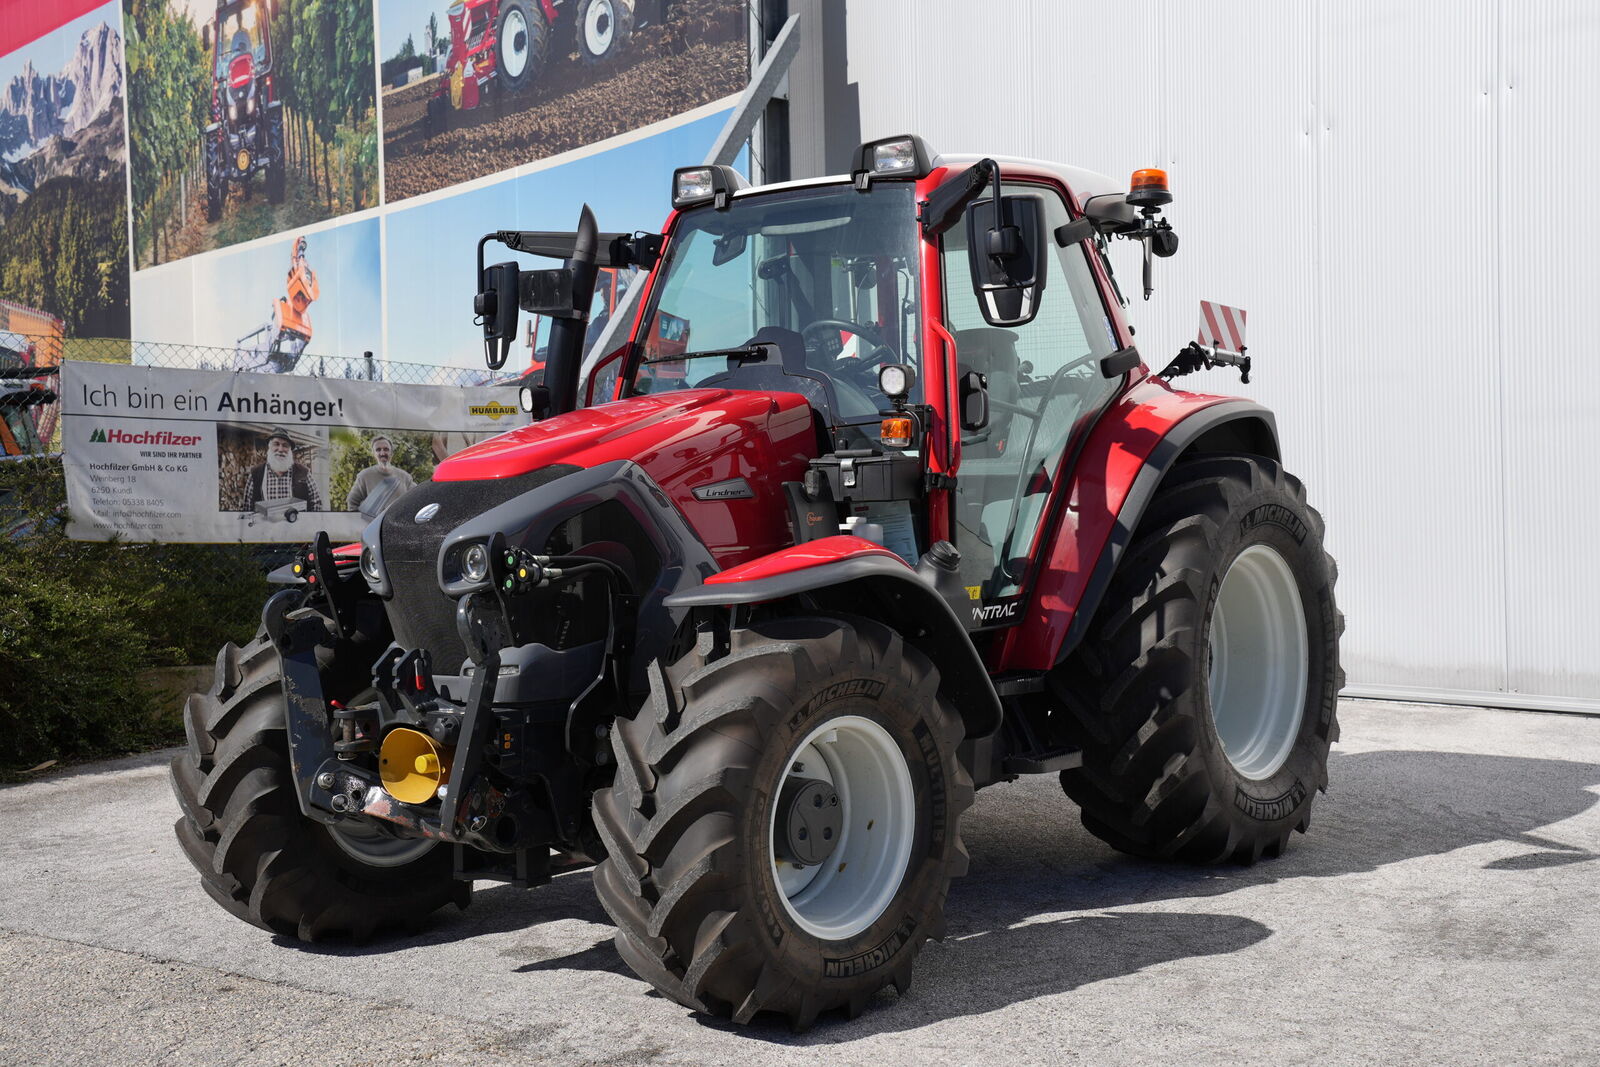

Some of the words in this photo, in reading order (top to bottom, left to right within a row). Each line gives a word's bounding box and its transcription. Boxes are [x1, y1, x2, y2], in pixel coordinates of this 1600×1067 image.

[83, 384, 117, 408] Ich
[128, 385, 164, 410] bin
[174, 389, 208, 411] ein
[217, 391, 344, 421] Anhänger!
[108, 429, 202, 446] Hochfilzer
[89, 463, 130, 471] Hochfilzer
[132, 463, 155, 472] GmbH
[706, 489, 745, 497] Lindner
[807, 679, 885, 716] MICHELIN
[1235, 791, 1295, 821] MICHELIN
[825, 934, 902, 978] MICHELIN
